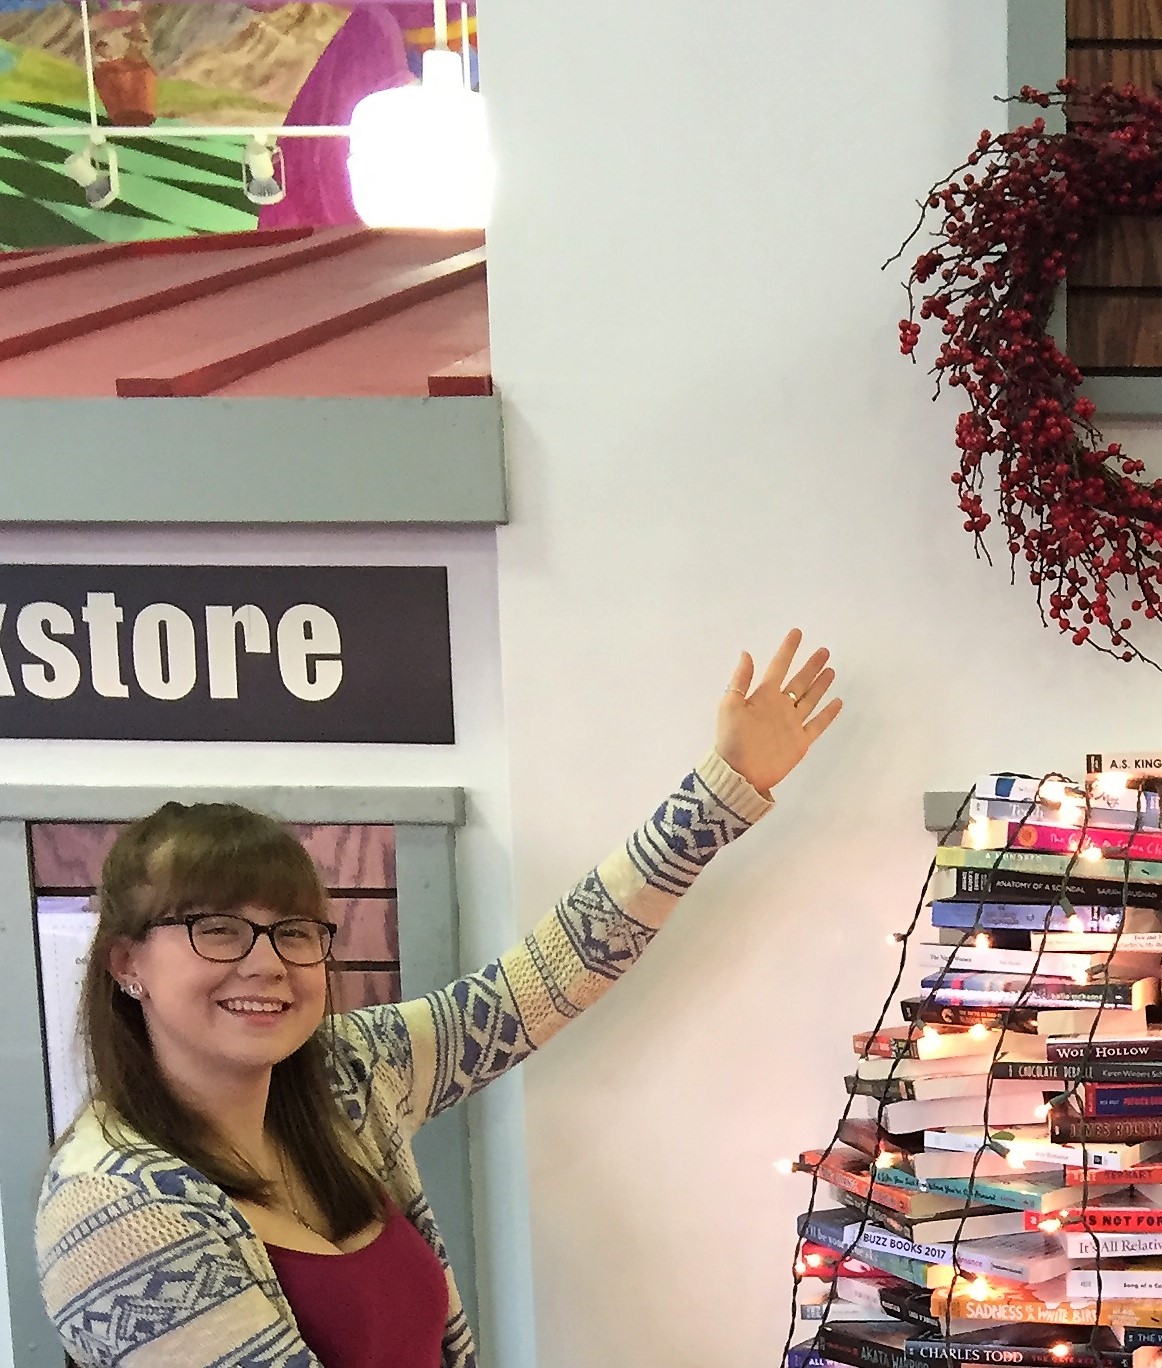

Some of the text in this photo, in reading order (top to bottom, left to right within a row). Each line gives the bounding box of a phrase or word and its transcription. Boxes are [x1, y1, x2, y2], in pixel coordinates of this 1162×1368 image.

[1110, 758, 1130, 769] A.S.
[1134, 758, 1162, 769] KING
[995, 879, 1031, 891] ANATOMY
[1096, 1045, 1150, 1058] HOLLOW
[1103, 1215, 1132, 1226] NOT
[864, 1233, 947, 1260] BUZZ BOOKS 2017
[1100, 1239, 1118, 1252] All
[966, 1302, 1023, 1319] SADNESS
[1138, 1333, 1155, 1343] THE
[861, 1346, 890, 1367] AKATA
[920, 1347, 1024, 1363] CHARLES TODD
